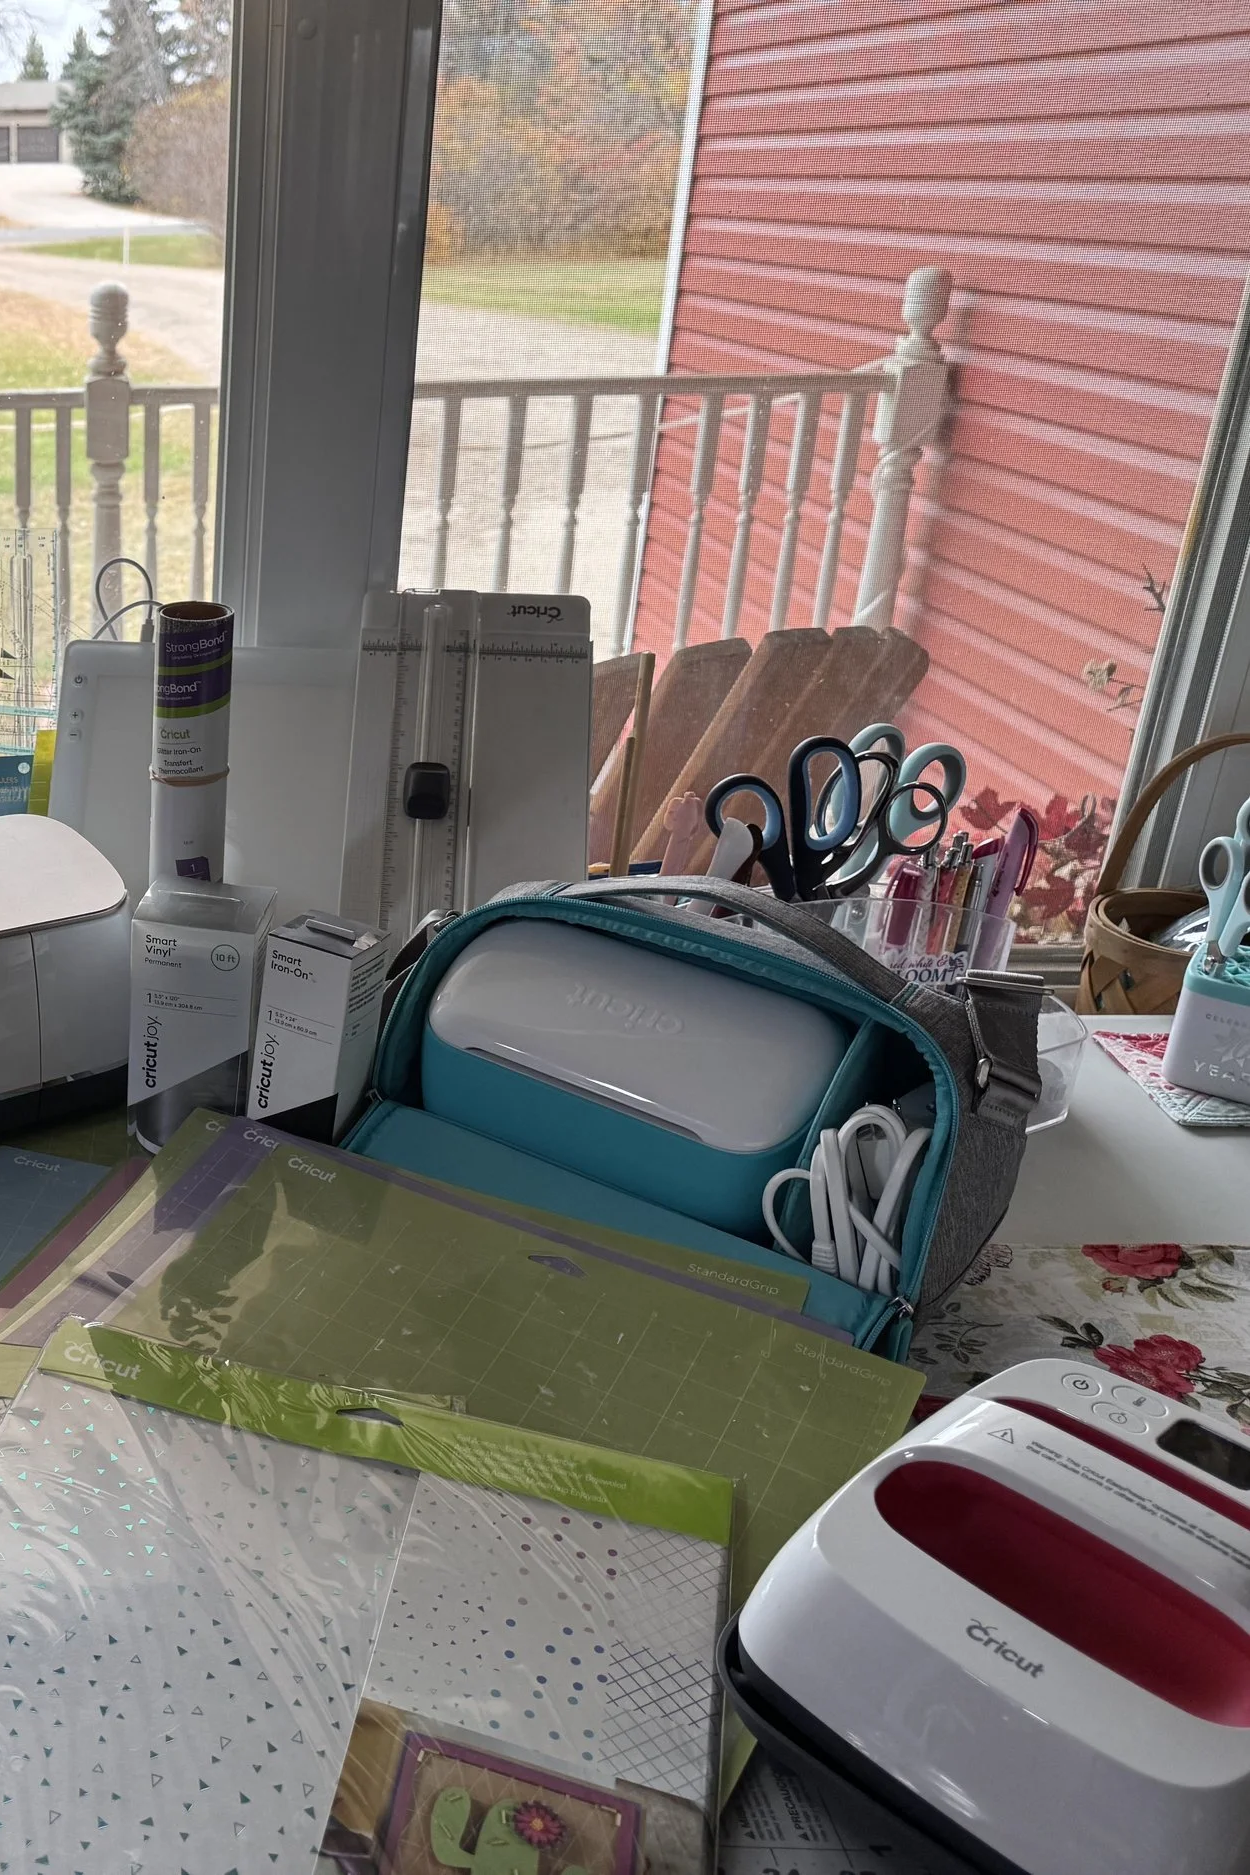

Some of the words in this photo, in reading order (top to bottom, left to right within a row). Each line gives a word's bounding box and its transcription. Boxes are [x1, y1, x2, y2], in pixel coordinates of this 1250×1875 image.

[509, 604, 564, 624] Cricut
[159, 726, 191, 740] Cricut
[157, 747, 172, 755] Glitter
[174, 746, 202, 755] Iron-On
[158, 765, 204, 775] Thermocollant
[164, 759, 193, 767] Transfert
[145, 934, 177, 947] Smart
[144, 957, 182, 969] Permanent
[215, 953, 225, 962] 10
[227, 954, 236, 964] ft
[272, 950, 302, 966] Smart
[908, 956, 933, 969] white
[936, 954, 948, 968] &
[904, 968, 947, 982] OOM
[146, 992, 152, 1004] 1
[267, 1010, 273, 1021] 1
[142, 1041, 157, 1089] cricut
[256, 1059, 273, 1109] cricut
[13, 1154, 63, 1173] Cricut
[287, 1154, 338, 1185] Cricut
[687, 1263, 780, 1296] StandardGrip
[63, 1341, 143, 1381] Cricut
[794, 1343, 892, 1387] StandardGrip
[966, 1618, 1045, 1679] Cricut
